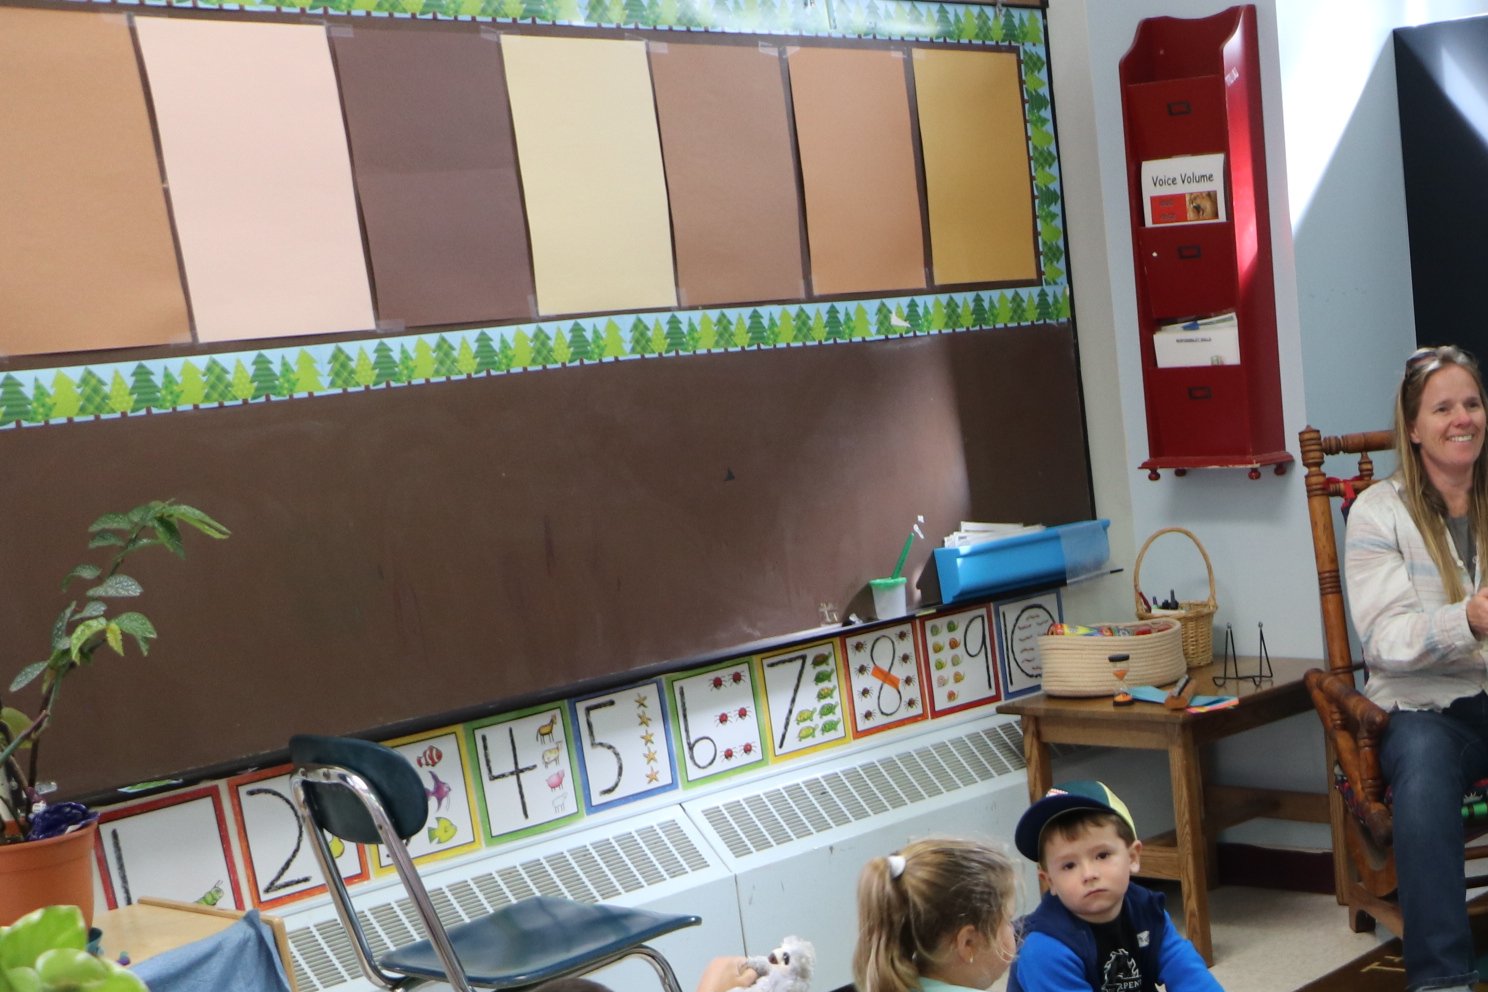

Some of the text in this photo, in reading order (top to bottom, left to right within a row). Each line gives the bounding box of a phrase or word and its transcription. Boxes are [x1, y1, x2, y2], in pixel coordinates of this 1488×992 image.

[1152, 172, 1214, 187] Voice Volume
[870, 634, 902, 717] 8
[963, 614, 993, 690] 9
[1002, 603, 1057, 687] 10
[680, 684, 718, 770] 6
[766, 653, 808, 749] 7
[482, 726, 537, 820] 4
[585, 698, 624, 796] 5
[246, 787, 313, 894] 2
